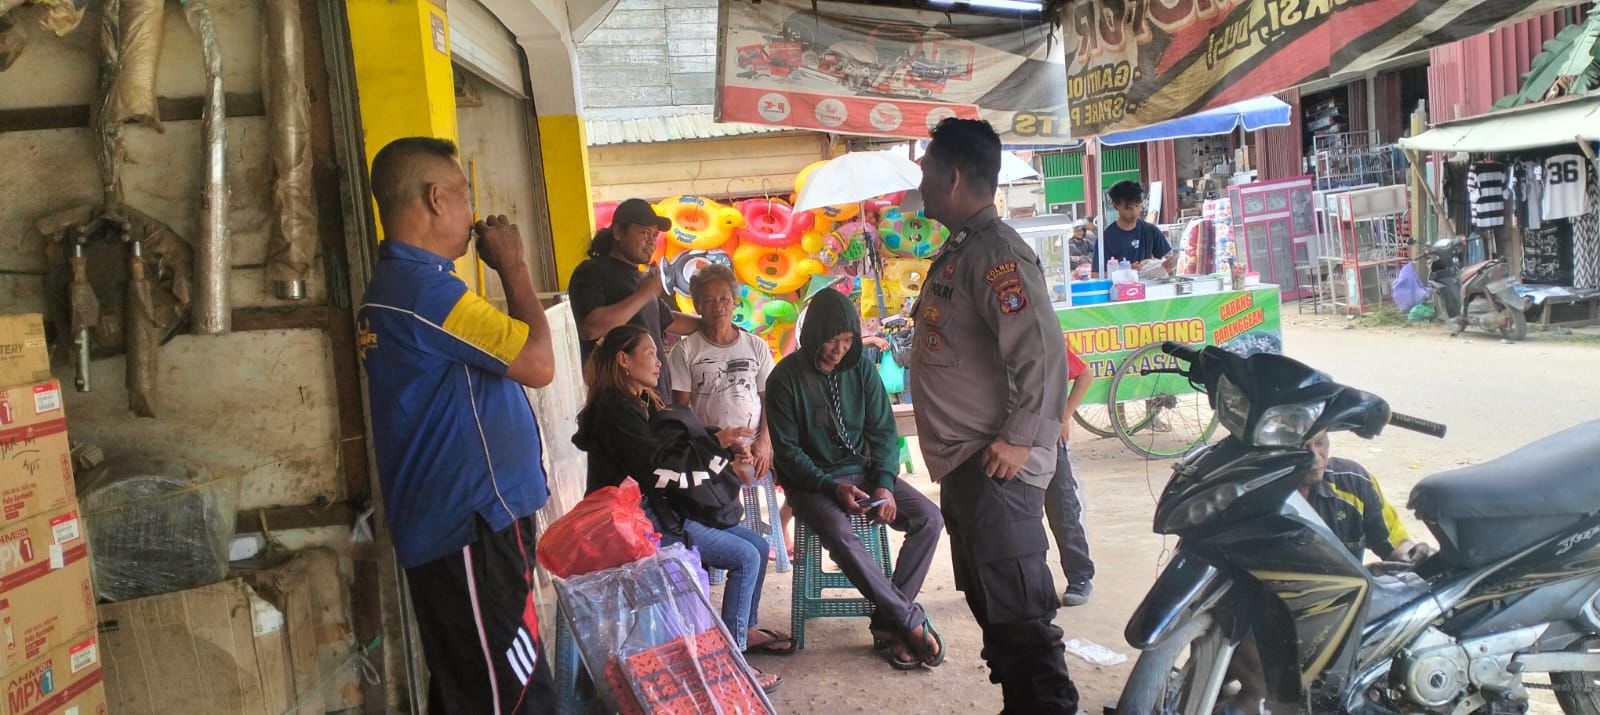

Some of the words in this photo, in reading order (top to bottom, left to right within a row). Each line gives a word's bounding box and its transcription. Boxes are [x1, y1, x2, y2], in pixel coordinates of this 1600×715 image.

[1548, 160, 1578, 185] 36
[930, 281, 954, 301] POLRI
[1220, 291, 1253, 322] CABANG
[1064, 327, 1121, 355] NTOL
[1123, 318, 1204, 349] DAGING
[1213, 306, 1264, 344] PARENGGEAN
